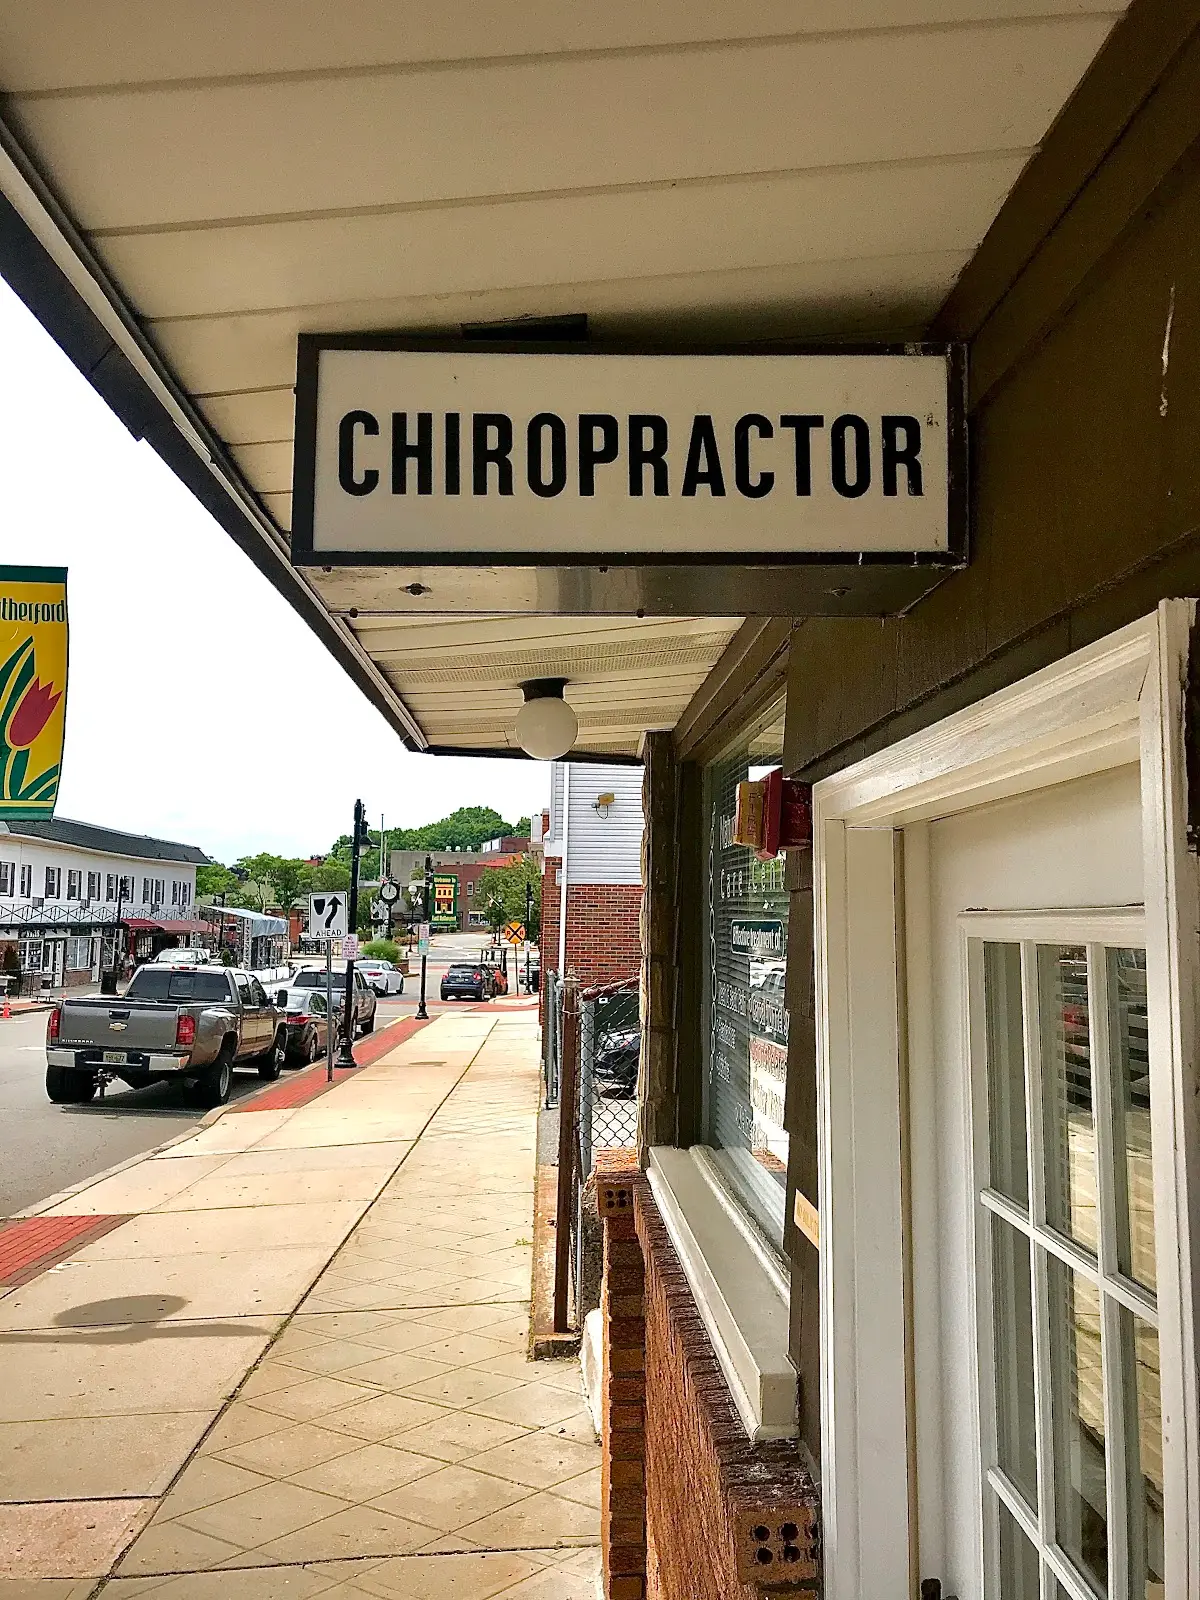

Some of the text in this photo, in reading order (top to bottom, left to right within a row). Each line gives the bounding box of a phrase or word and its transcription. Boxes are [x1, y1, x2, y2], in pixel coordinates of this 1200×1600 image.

[337, 410, 924, 499] CHIROPRACTOR
[0, 597, 65, 625] therford
[719, 814, 737, 850] Natu
[747, 792, 756, 836] FIRE
[720, 857, 786, 899] Care Cent
[315, 929, 342, 937] AHEAD
[751, 926, 775, 950] treatment
[775, 925, 781, 951] of
